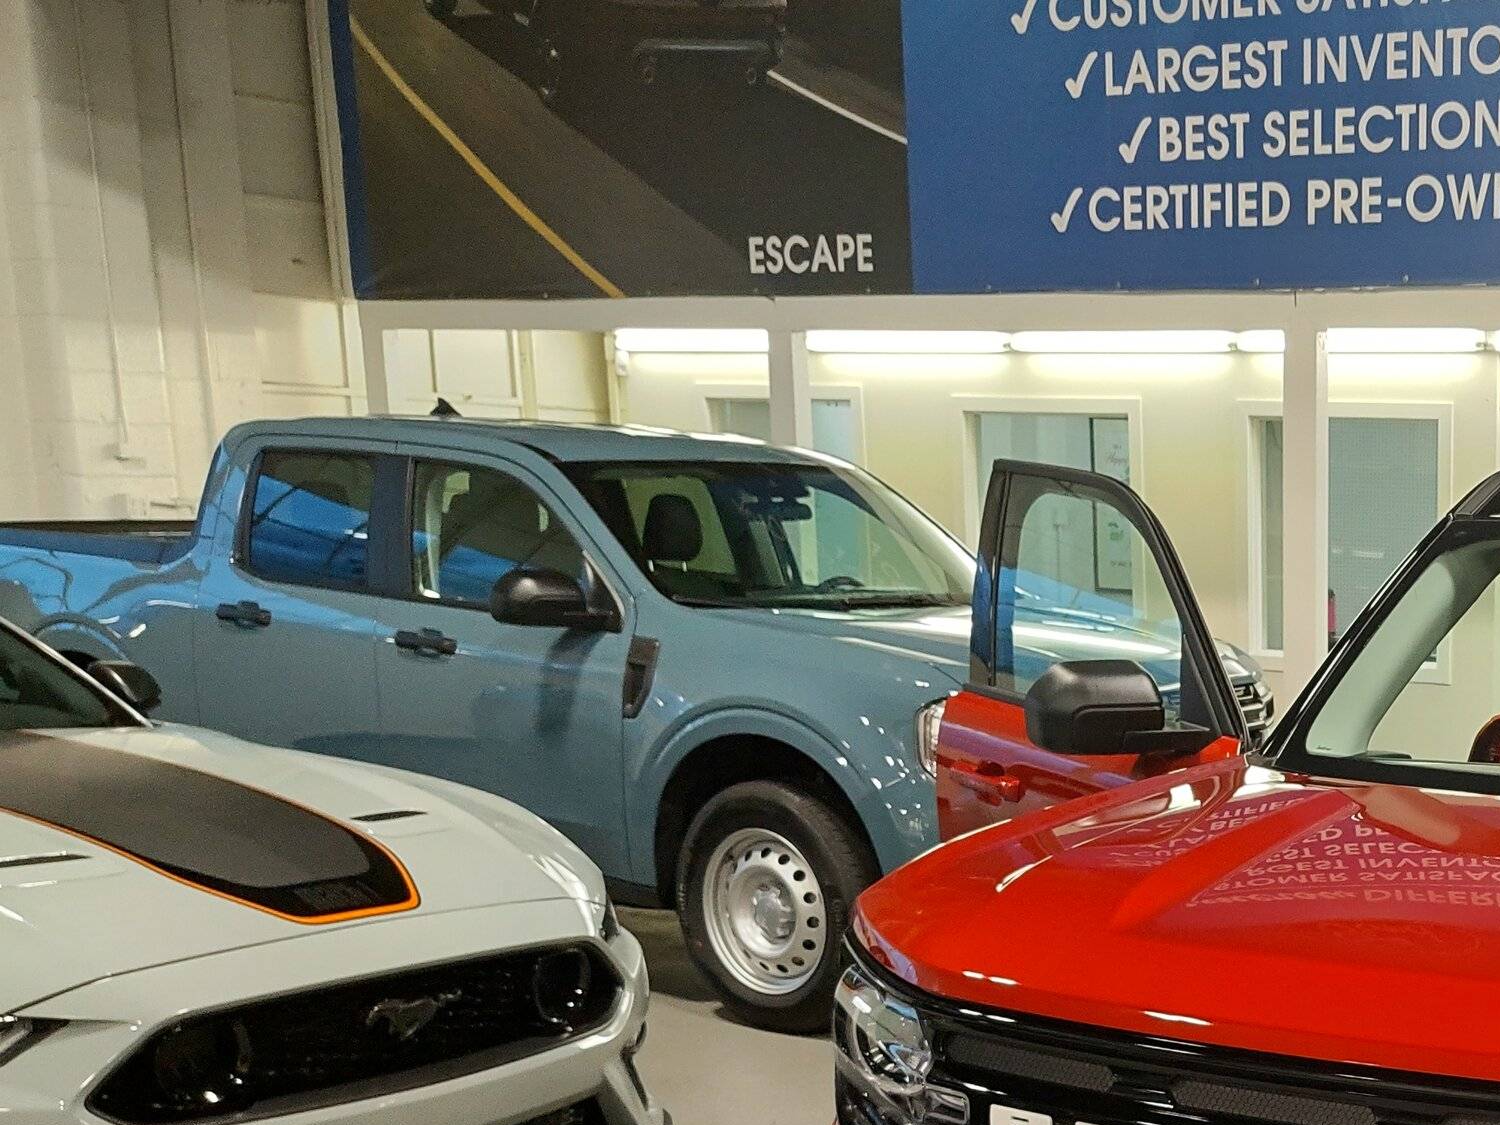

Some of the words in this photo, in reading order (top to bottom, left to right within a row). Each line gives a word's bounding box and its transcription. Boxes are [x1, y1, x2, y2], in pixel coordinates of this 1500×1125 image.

[1105, 40, 1289, 96] LARGEST
[1158, 112, 1250, 162] BEST
[1088, 181, 1291, 232] CERTIFIED
[748, 233, 874, 274] ESCAPE
